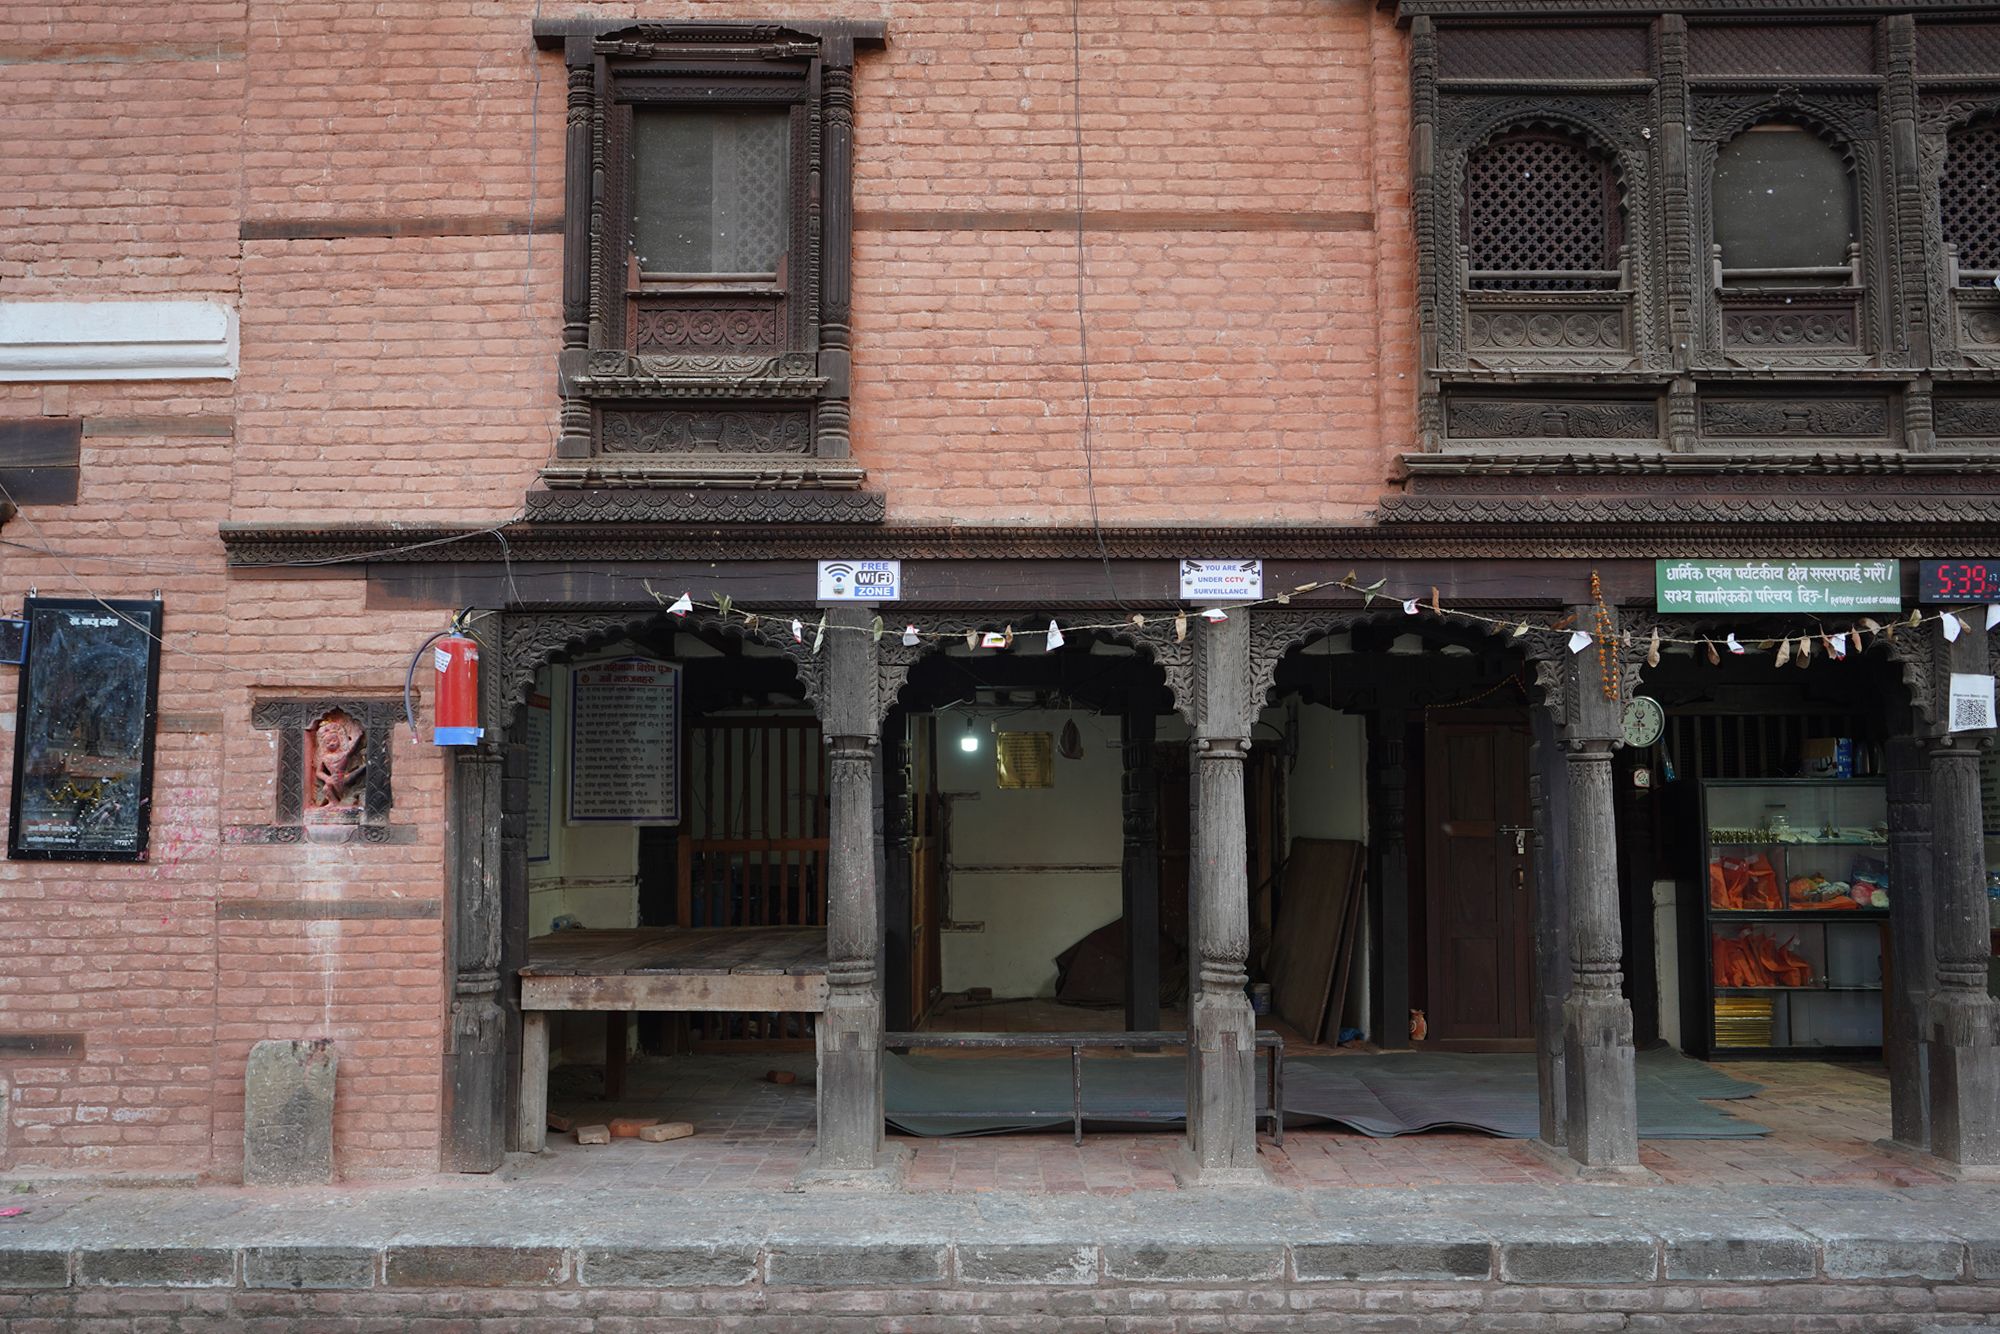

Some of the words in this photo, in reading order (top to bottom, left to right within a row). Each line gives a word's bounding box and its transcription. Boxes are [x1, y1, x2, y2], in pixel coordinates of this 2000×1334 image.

[861, 562, 888, 570] FREE
[1666, 562, 1704, 580] धार्मिक
[1788, 562, 1808, 584] क्षेत्र
[1810, 563, 1862, 583] सरसफाई
[857, 573, 891, 584] WiFi
[1938, 565, 1987, 593] 5:39
[858, 588, 891, 596] ZONE
[1694, 586, 1753, 607] नागरिकको
[1754, 586, 1793, 604] परिचय
